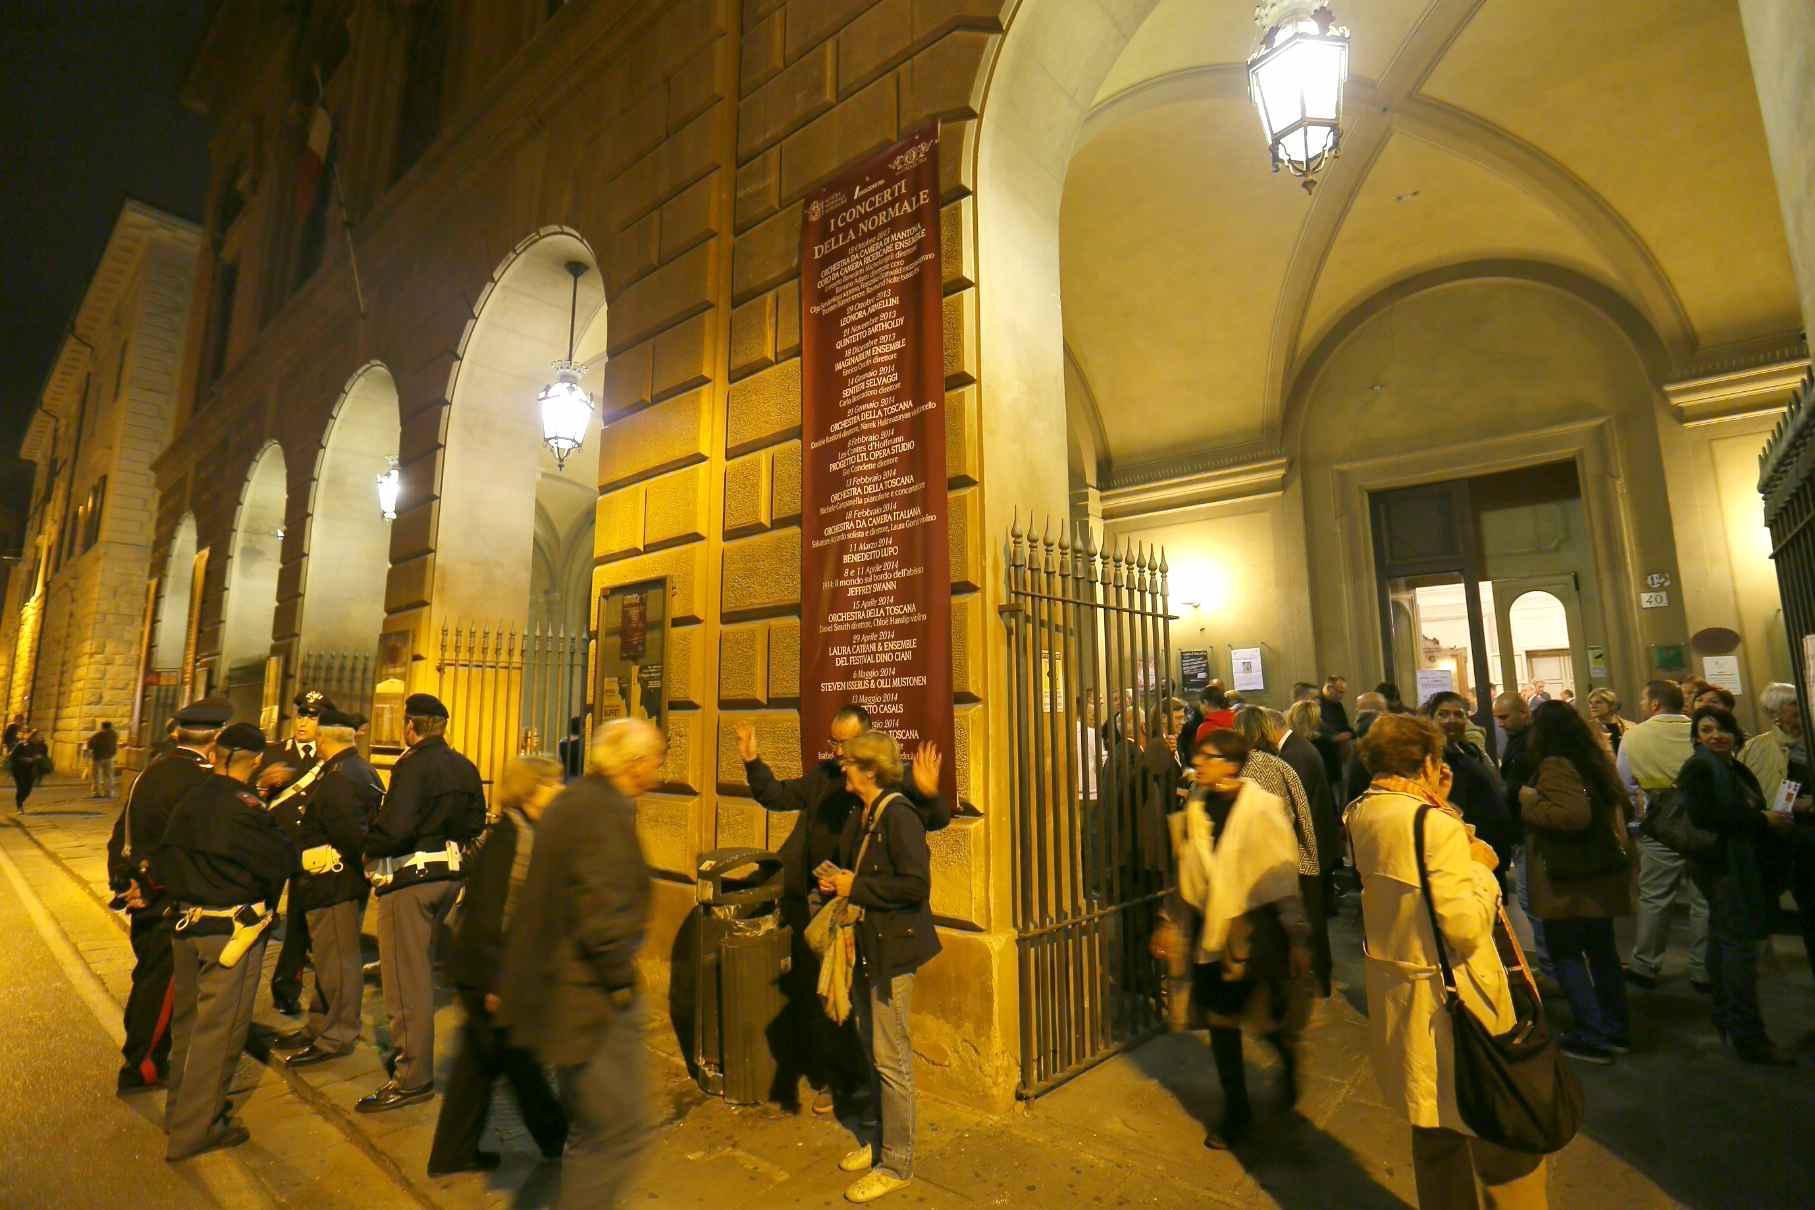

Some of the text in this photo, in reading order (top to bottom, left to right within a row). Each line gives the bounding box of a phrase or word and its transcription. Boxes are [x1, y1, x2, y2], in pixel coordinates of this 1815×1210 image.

[830, 217, 834, 232] I
[837, 178, 906, 228] CONCERTI
[813, 227, 854, 260] DELLA
[859, 188, 928, 236] NORMALE
[894, 228, 925, 250] ENSEMBLE
[840, 307, 866, 326] LEONORA
[867, 295, 899, 314] ARMELLINI
[880, 308, 896, 321] 2013
[835, 315, 904, 350] QUINTETTO BARTHOLDY
[879, 331, 895, 343] 2013
[871, 337, 906, 356] ENSEMBLE
[878, 362, 894, 375] 2014
[842, 370, 897, 398] SENTIERI SELVAGGI
[830, 399, 912, 433] ORCHESTRA DELLA TOSCANA
[851, 431, 879, 446] Febbraio
[880, 427, 894, 438] 2014
[867, 434, 903, 451] d'Hoffmann
[829, 454, 856, 473] PROGETTO
[869, 446, 890, 460] OPERA
[891, 440, 914, 454] STUDIO
[852, 471, 882, 485] Febbraio
[882, 468, 896, 479] 2014
[830, 474, 914, 503] ORCHESTRA DELLA TOSCANA
[853, 504, 882, 518] Febbraio
[882, 501, 896, 512] 2014
[824, 520, 854, 536] ORCHESTRA
[856, 518, 866, 528] DA
[893, 506, 921, 521] ITALIANA
[878, 536, 892, 547] 2014
[843, 545, 898, 564] BENEDETTO LUPO
[843, 567, 849, 576] 8
[850, 569, 854, 577] e
[856, 566, 864, 575] 11
[883, 559, 898, 570] 2014
[839, 575, 863, 586] mondo
[872, 571, 892, 581] bordo
[847, 584, 872, 596] JEFFREY
[872, 580, 896, 593] SWANN
[852, 600, 860, 609] 15
[878, 594, 894, 605] 2014
[828, 602, 916, 623] ORCHESTRA DELLA TOSCANA
[878, 629, 894, 640] 2014
[828, 646, 851, 657] LAURA
[877, 642, 882, 651] &
[884, 638, 917, 651] ENSEMBLE
[835, 650, 911, 666] DEL FESTIVAL DINO CIANI
[879, 667, 895, 677] 2014
[820, 681, 845, 692] STEVEN
[870, 679, 875, 688] &
[876, 678, 890, 687] OLLI
[891, 675, 926, 687] MUSTONEN
[858, 693, 882, 704] Maggio
[882, 692, 897, 702] 2014
[878, 703, 903, 714] CASALS
[884, 718, 899, 728] 2014
[888, 730, 919, 740] TOSCANA
